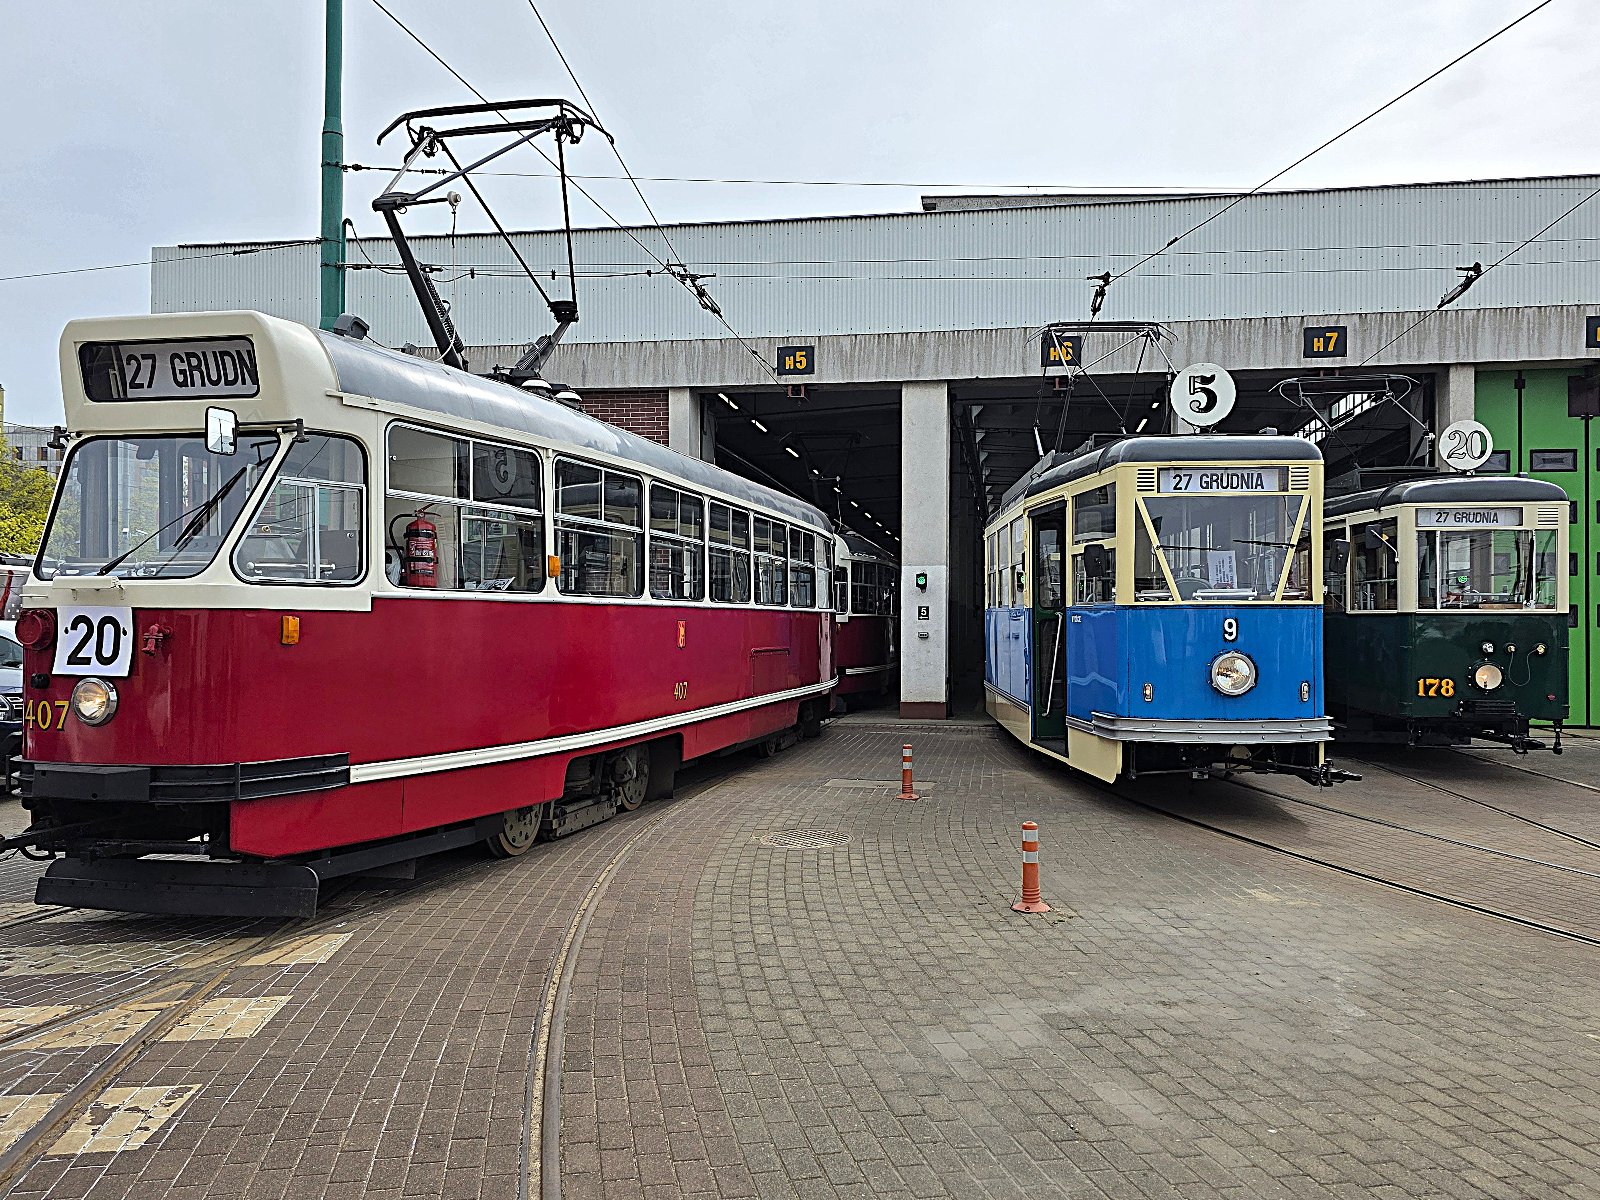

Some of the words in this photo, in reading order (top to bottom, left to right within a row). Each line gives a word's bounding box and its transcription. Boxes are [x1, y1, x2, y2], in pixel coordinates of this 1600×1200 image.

[1050, 341, 1073, 361] H6
[1313, 332, 1339, 352] H7
[126, 353, 157, 389] 27
[169, 349, 258, 388] GRUDN
[785, 351, 807, 370] H5
[1189, 374, 1218, 413] 5
[1447, 430, 1488, 460] 20
[1172, 473, 1193, 490] 27
[1199, 472, 1265, 490] GRUDNIA
[1435, 511, 1450, 524] 27
[1454, 511, 1499, 524] GRUDNIA
[920, 607, 927, 616] 5
[1223, 617, 1238, 641] 9
[66, 615, 122, 666] 20
[674, 682, 688, 700] 407
[1416, 677, 1455, 698] 178
[24, 700, 70, 732] 407
